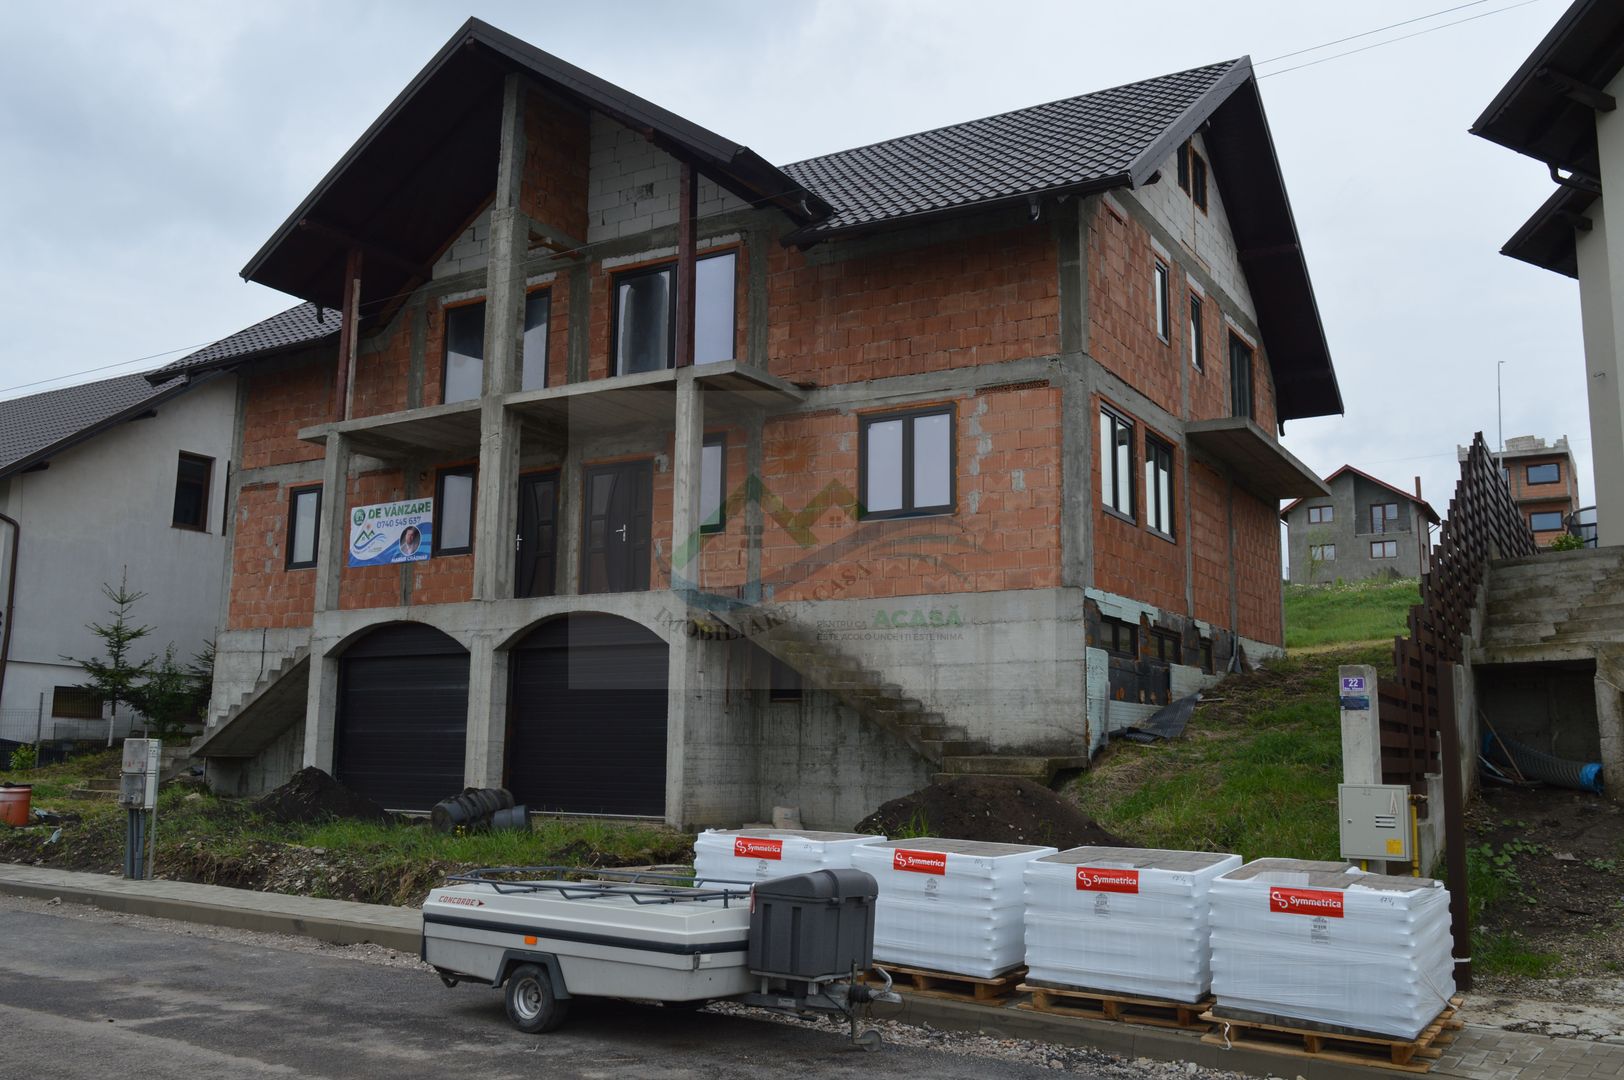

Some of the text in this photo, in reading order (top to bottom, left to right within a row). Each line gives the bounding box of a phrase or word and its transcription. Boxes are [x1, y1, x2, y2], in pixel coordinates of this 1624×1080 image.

[368, 501, 431, 519] DE VÂNZARE
[376, 516, 422, 528] 0740 545 637
[1348, 679, 1359, 687] 22
[747, 843, 780, 853] Symmetrica
[908, 856, 945, 867] Symmetrica
[1093, 874, 1137, 885] Symmetrica
[439, 895, 476, 906] CONCORDE
[1290, 895, 1342, 908] Symmetrica
